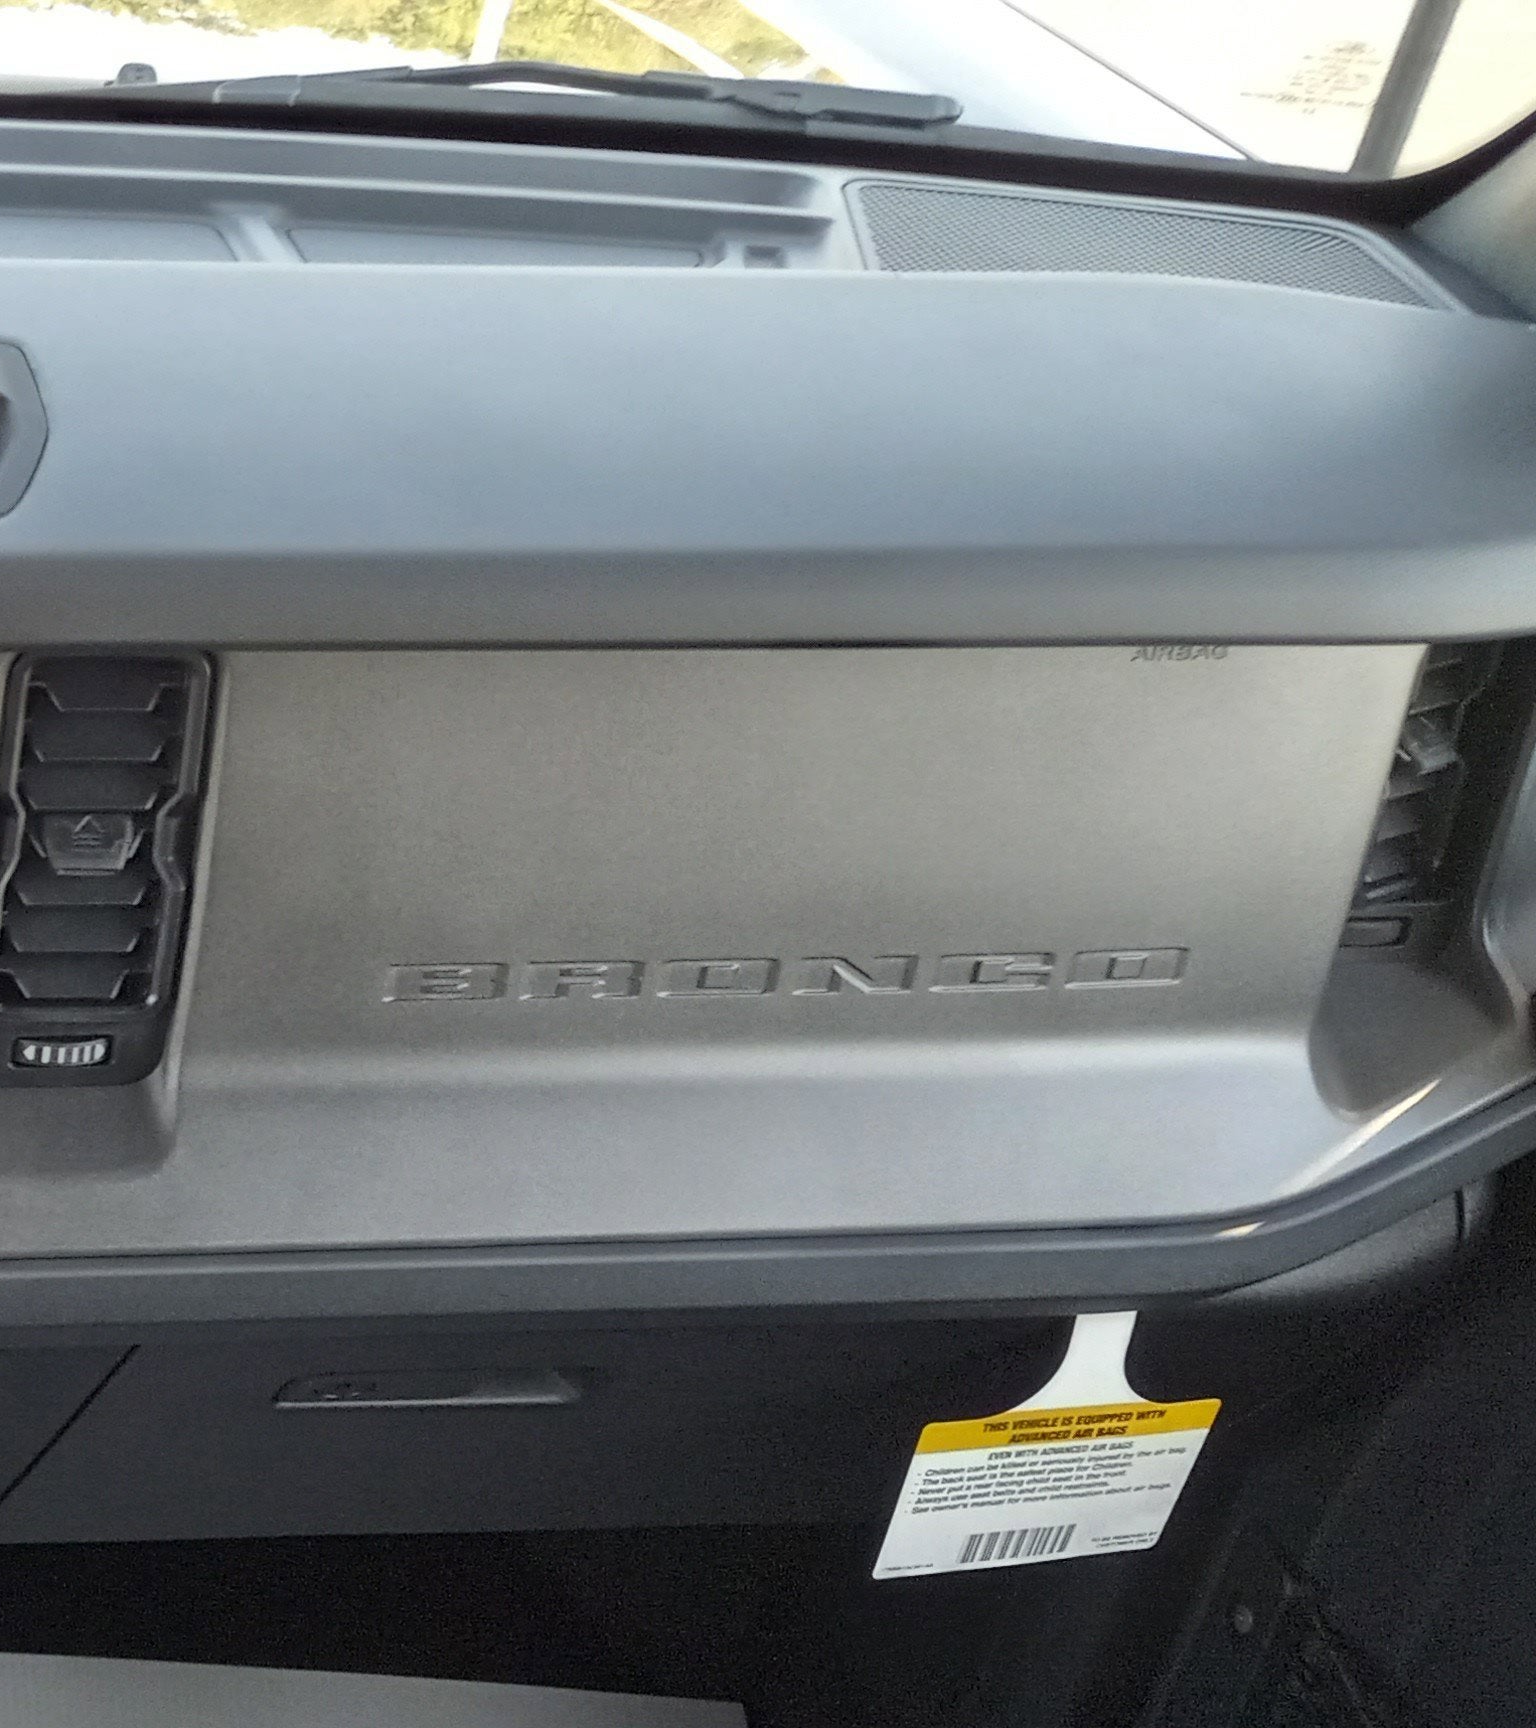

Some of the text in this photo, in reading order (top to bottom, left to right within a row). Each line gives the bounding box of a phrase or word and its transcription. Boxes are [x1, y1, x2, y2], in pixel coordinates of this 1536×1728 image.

[382, 946, 1190, 1003] BRONCO
[983, 1410, 1167, 1432] THIS VEHICLE IS EQUIPPED WITH
[1009, 1426, 1128, 1443] ADVANCED AIR BAGS
